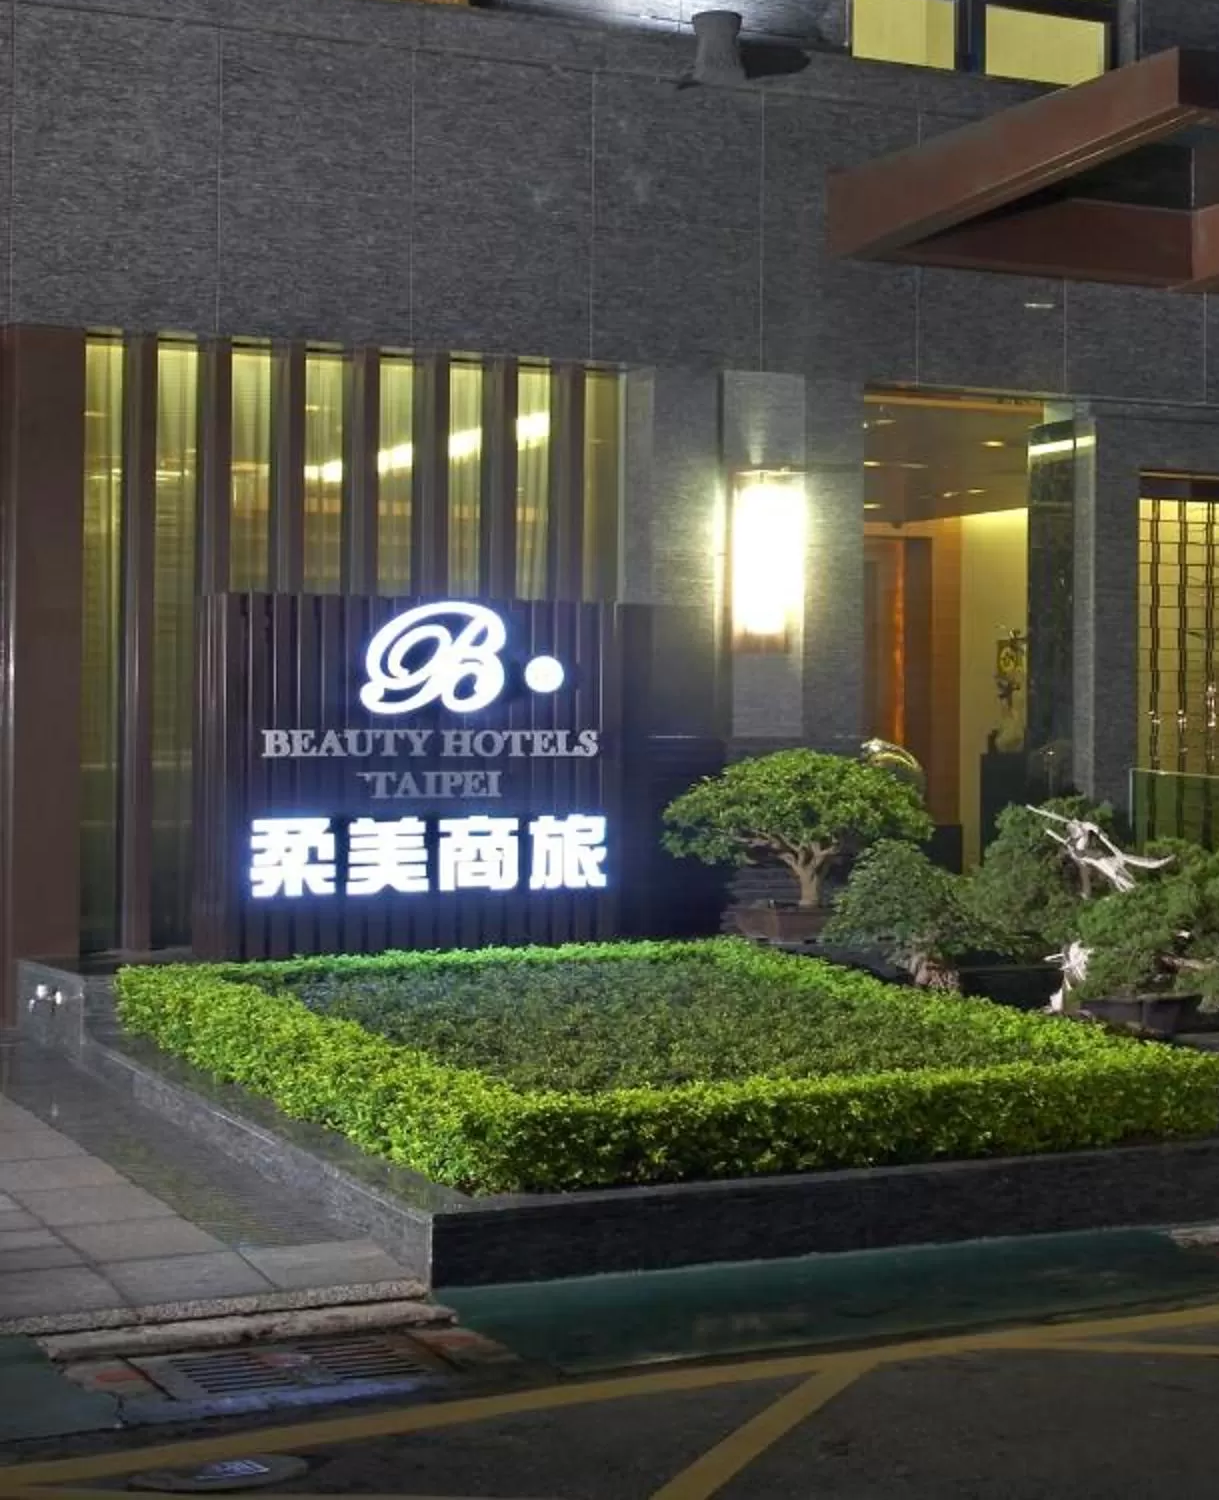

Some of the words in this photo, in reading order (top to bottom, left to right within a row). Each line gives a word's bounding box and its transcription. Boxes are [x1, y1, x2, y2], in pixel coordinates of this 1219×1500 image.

[261, 728, 435, 758] BEAUTY
[440, 728, 599, 758] HOTELS
[357, 771, 502, 799] TAIPEI
[250, 814, 608, 897] 柔美商旅
